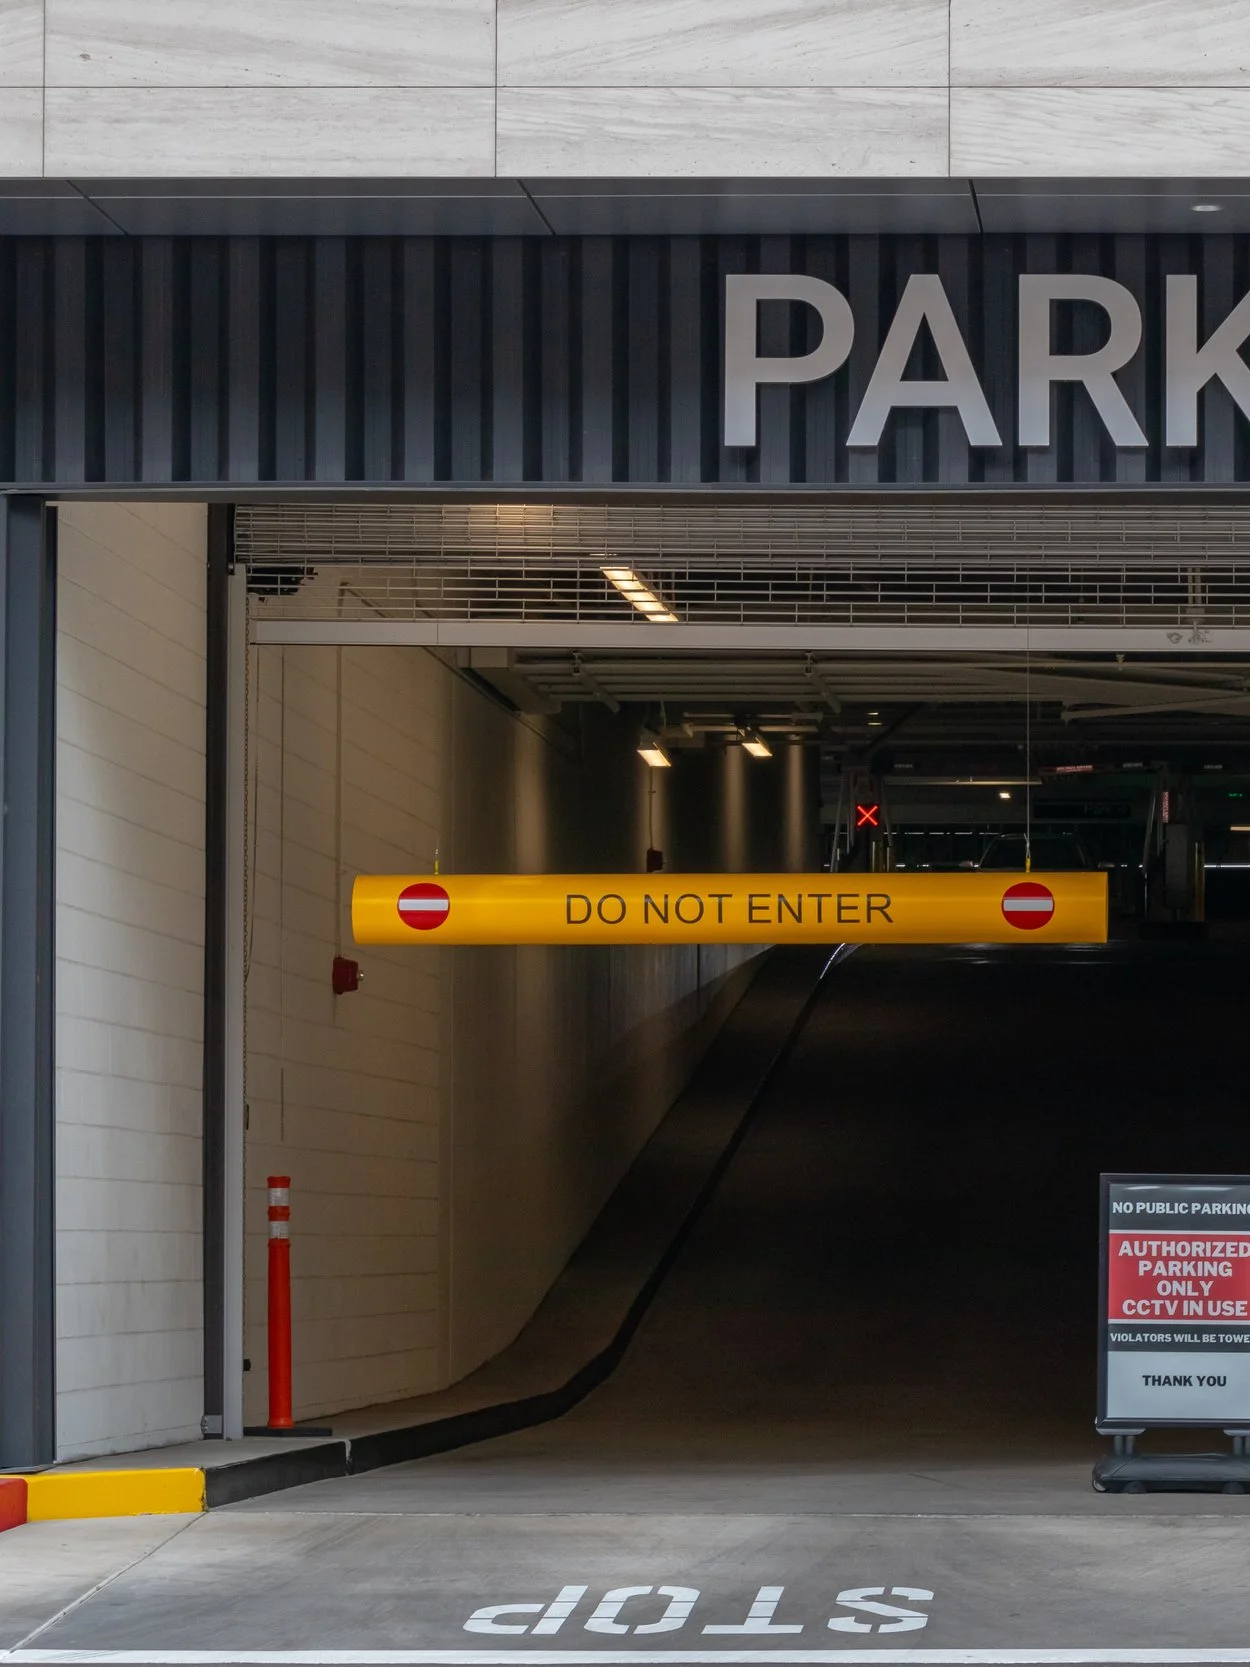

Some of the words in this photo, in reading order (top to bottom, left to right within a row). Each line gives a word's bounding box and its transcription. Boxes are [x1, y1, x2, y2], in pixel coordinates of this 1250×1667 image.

[567, 894, 626, 924] DO
[644, 894, 732, 924] NOT
[749, 894, 893, 923] ENTER
[1112, 1202, 1134, 1214] NO
[1135, 1203, 1189, 1214] PUBLIC
[1138, 1261, 1233, 1277] PARKING
[1156, 1280, 1214, 1297] ONLY
[1122, 1300, 1179, 1316] CCTV
[1182, 1300, 1204, 1316] IN
[1207, 1301, 1248, 1317] USE
[1109, 1333, 1172, 1343] VIOLATORS
[1173, 1334, 1201, 1343] WILL
[1202, 1334, 1217, 1343] BE
[1141, 1375, 1194, 1387] THANK
[1195, 1376, 1227, 1387] YOU
[463, 1585, 934, 1634] STOP
